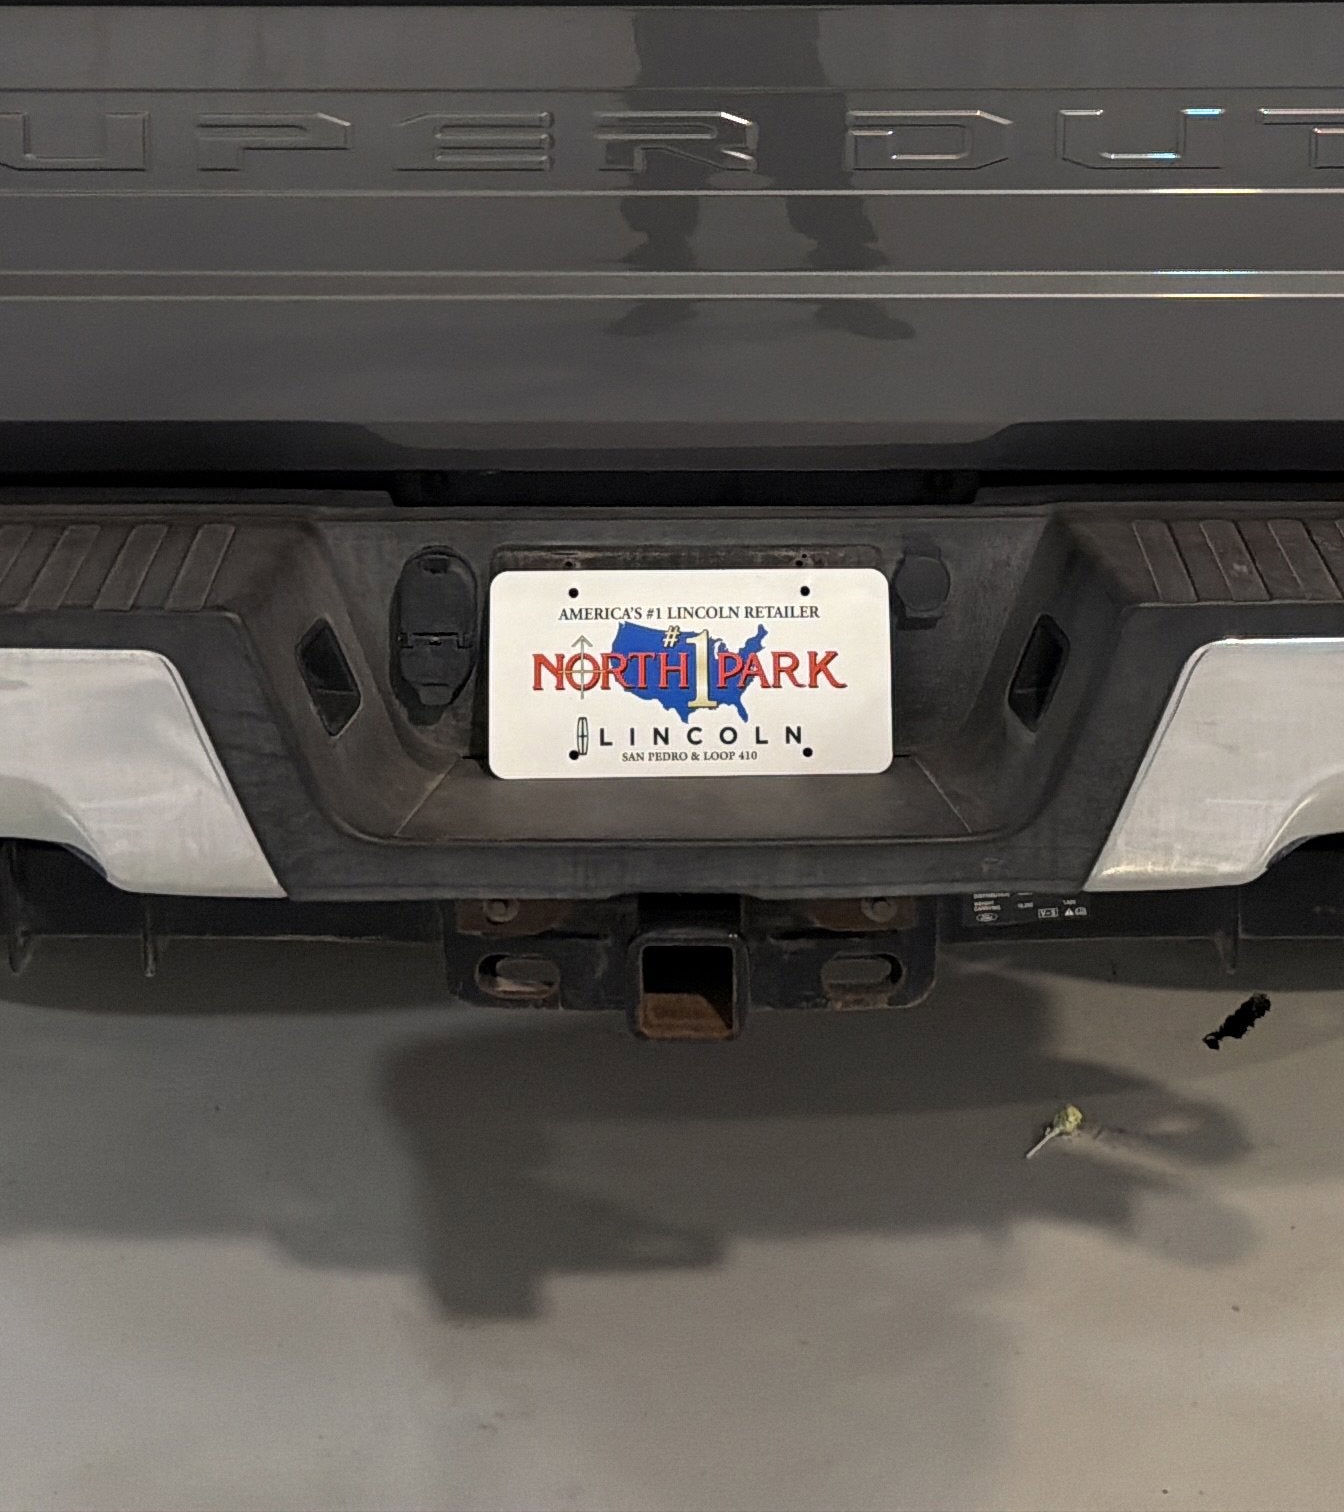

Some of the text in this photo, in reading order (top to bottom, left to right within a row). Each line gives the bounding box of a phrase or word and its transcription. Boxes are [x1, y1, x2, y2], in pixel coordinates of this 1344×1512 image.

[558, 605, 820, 620] AMERICA'S #1 LINCOLN RETAILER
[532, 651, 849, 691] NORTH PARK
[599, 726, 802, 747] LINCOLN
[622, 750, 759, 762] SAN PEDRO & LOOP 410
